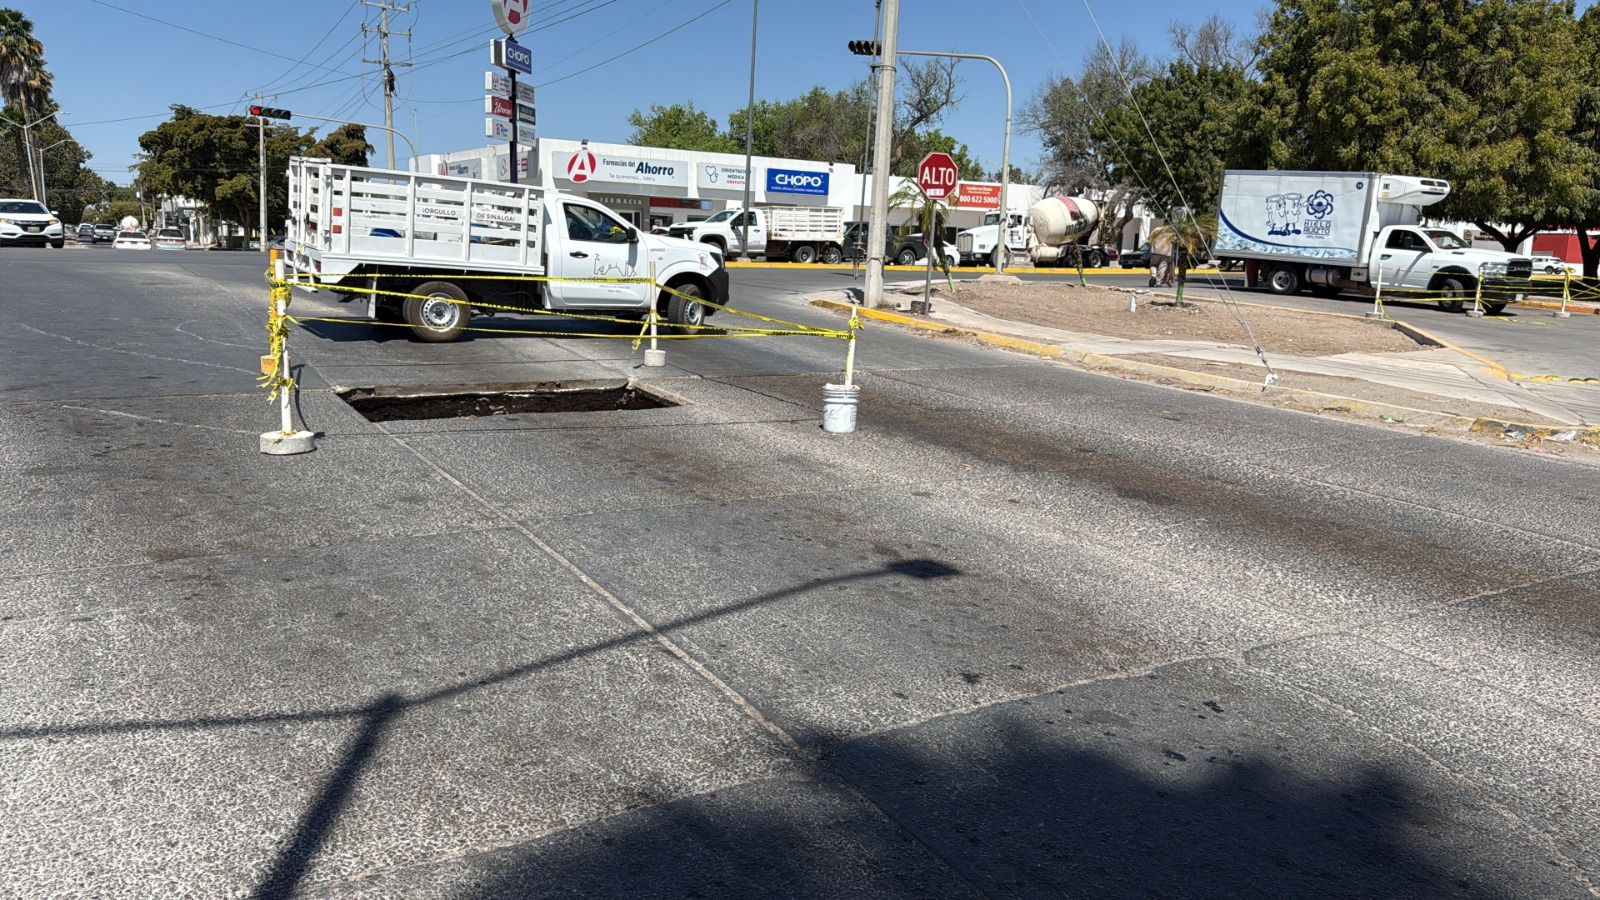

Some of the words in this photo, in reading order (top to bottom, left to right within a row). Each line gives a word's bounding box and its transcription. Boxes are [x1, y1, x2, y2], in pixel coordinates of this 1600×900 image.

[508, 48, 529, 65] CHOPO
[602, 159, 627, 167] Farmacias
[635, 162, 674, 176] Ahorro
[721, 167, 751, 175] ORIENTACI
[775, 173, 822, 187] CHOPO
[921, 166, 955, 185] ALTO
[600, 196, 642, 205] FARMACIA
[960, 195, 971, 203] 800
[984, 196, 998, 204] 5000
